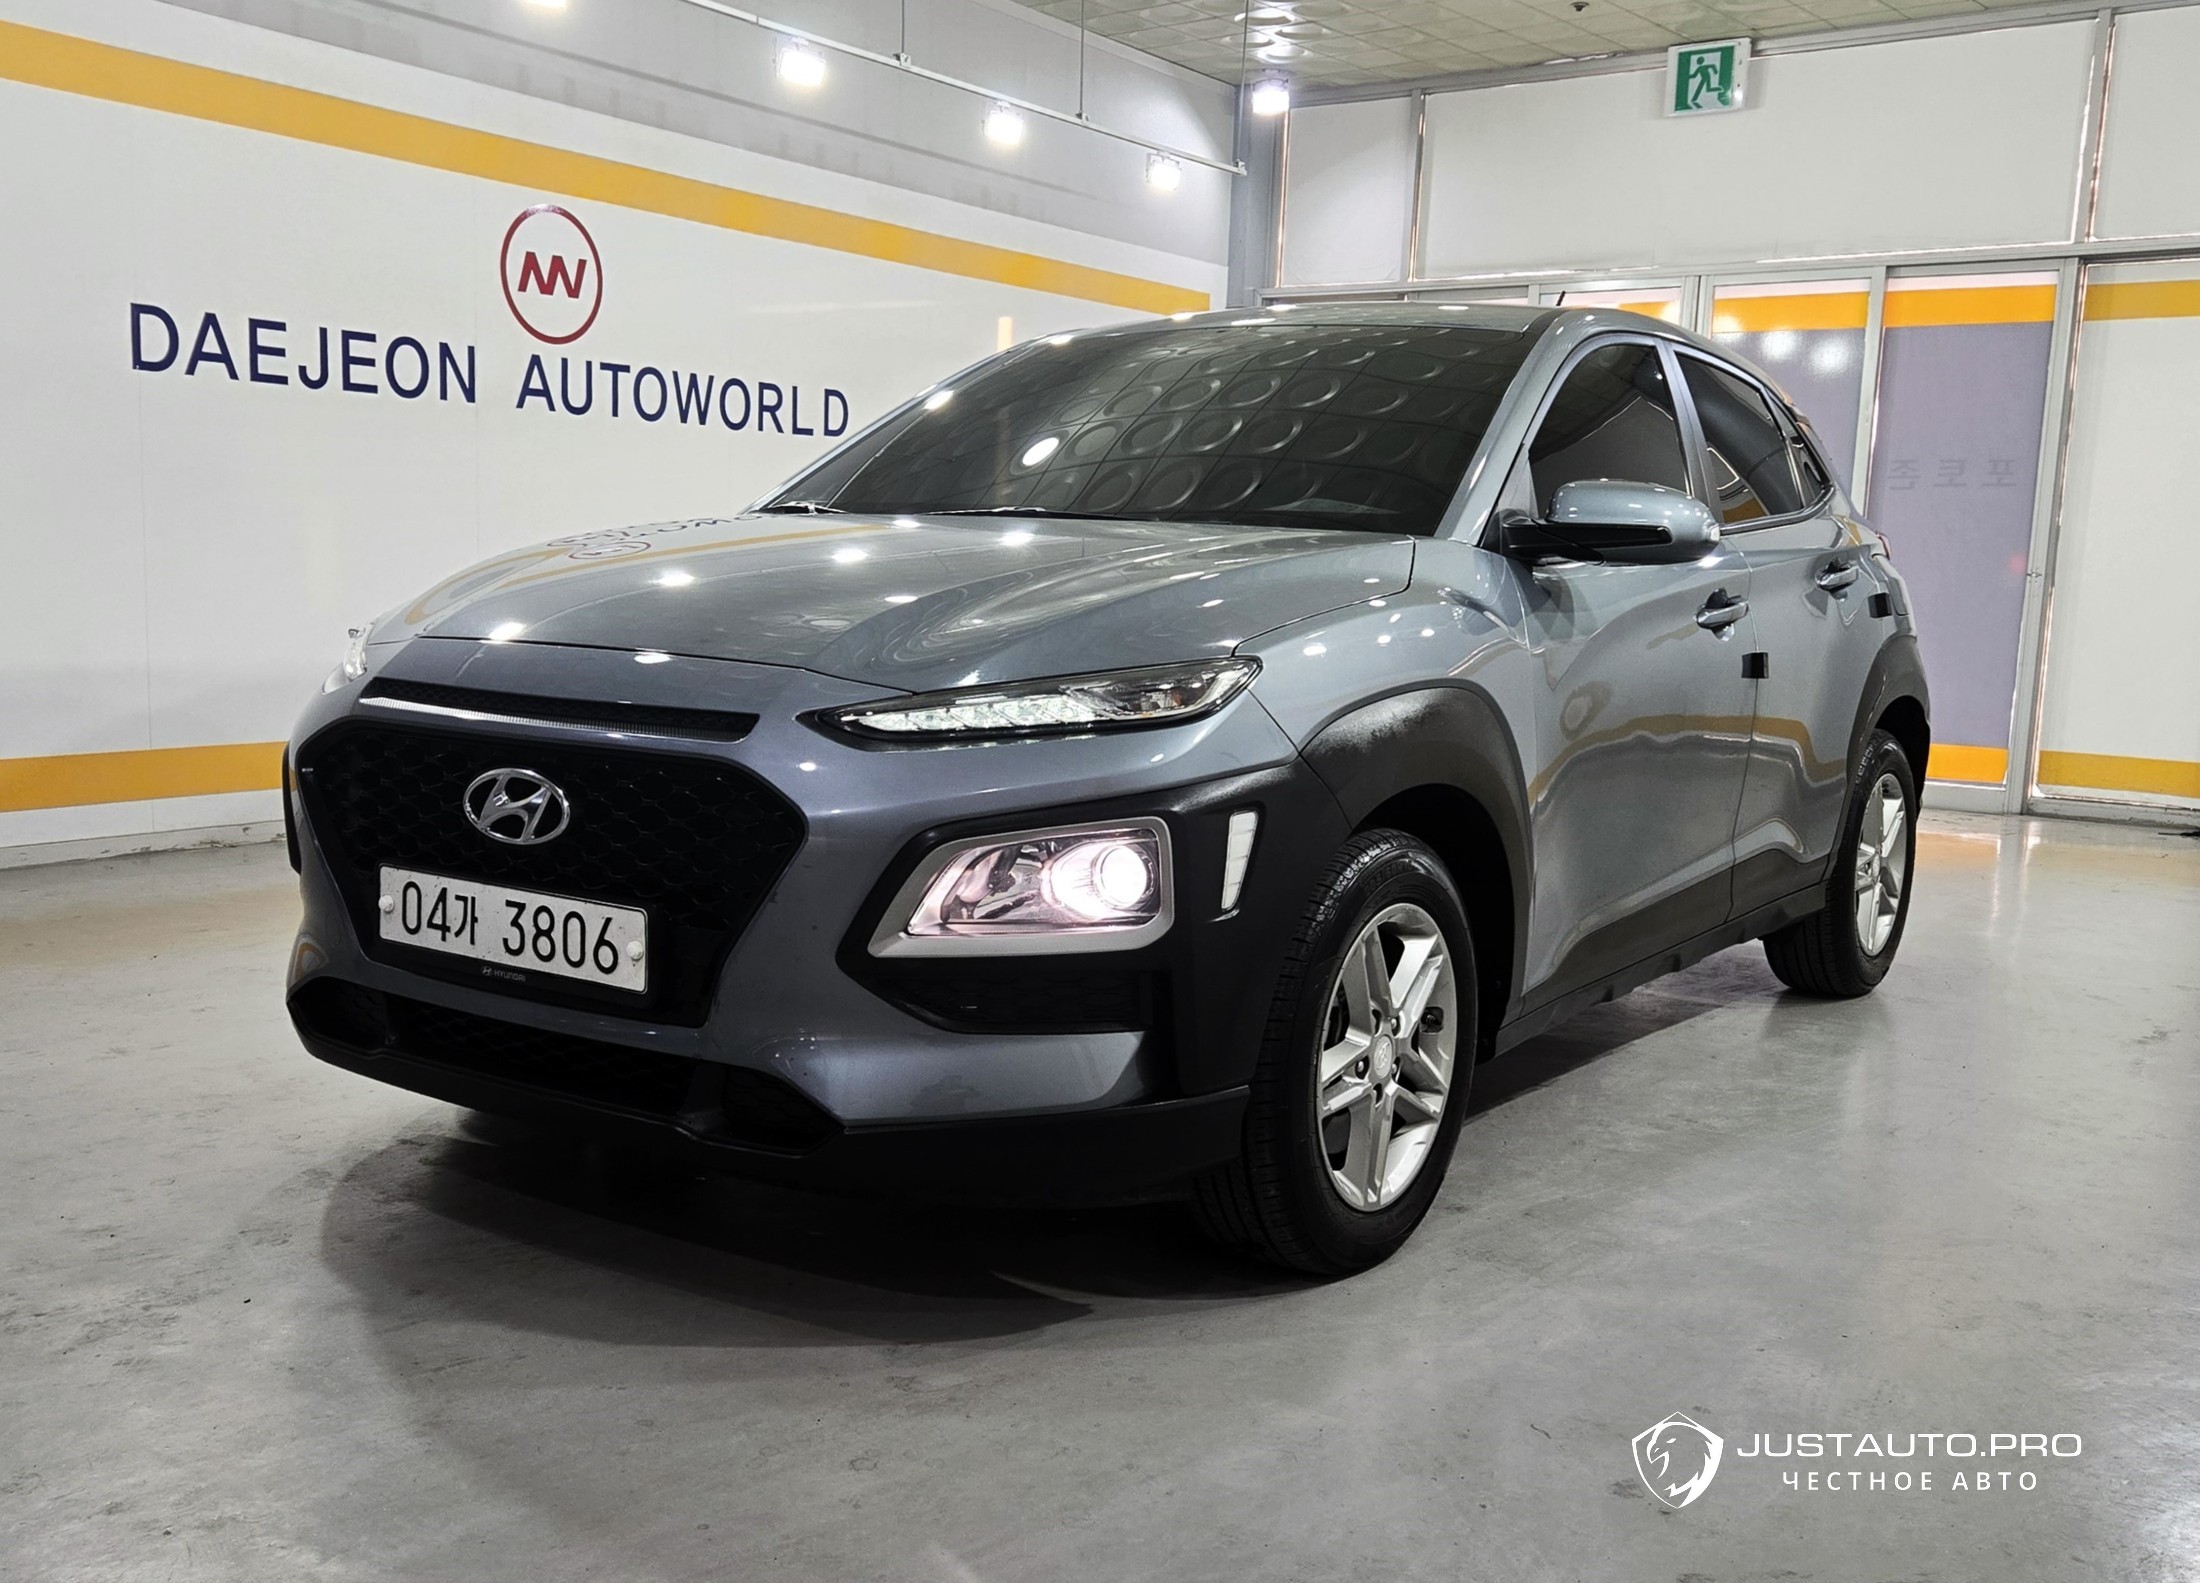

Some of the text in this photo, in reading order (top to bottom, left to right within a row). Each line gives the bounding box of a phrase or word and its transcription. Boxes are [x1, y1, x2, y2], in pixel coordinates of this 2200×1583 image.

[130, 302, 849, 437] DAEJEON AUTOWORLD
[401, 880, 619, 975] 04가 3806
[494, 969, 526, 983] HYUNDAI
